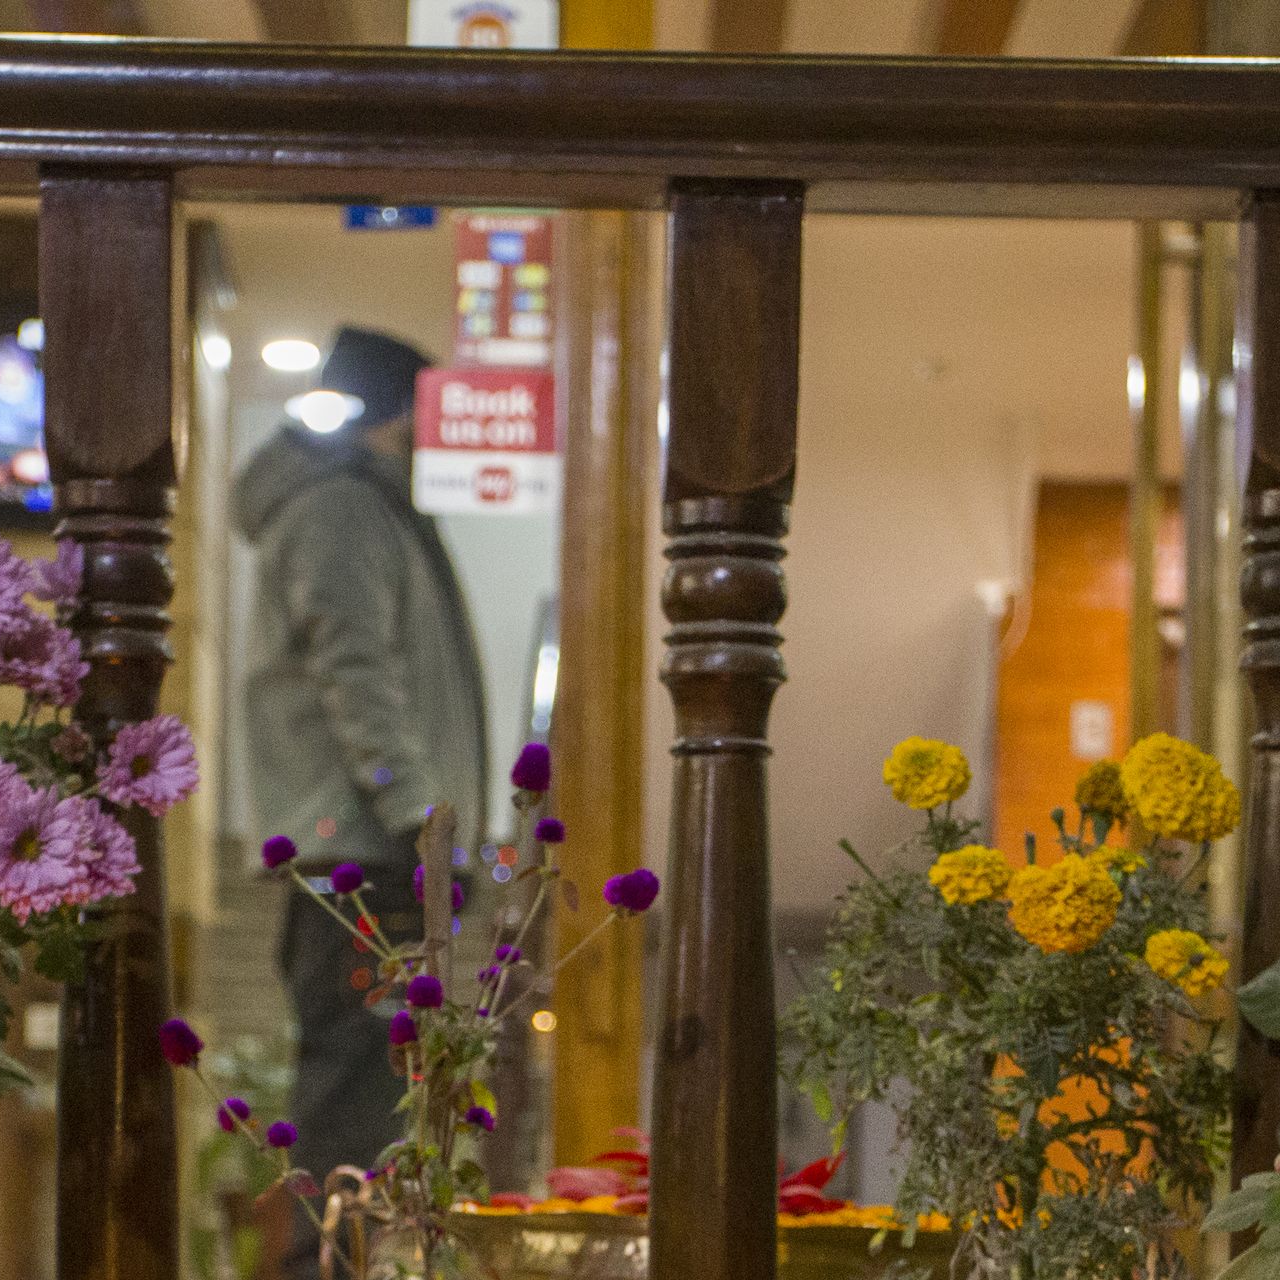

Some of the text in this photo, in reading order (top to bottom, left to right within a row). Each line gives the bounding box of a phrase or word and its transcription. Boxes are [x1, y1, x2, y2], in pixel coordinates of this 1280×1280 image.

[441, 382, 537, 416] Book
[440, 419, 537, 446] us on
